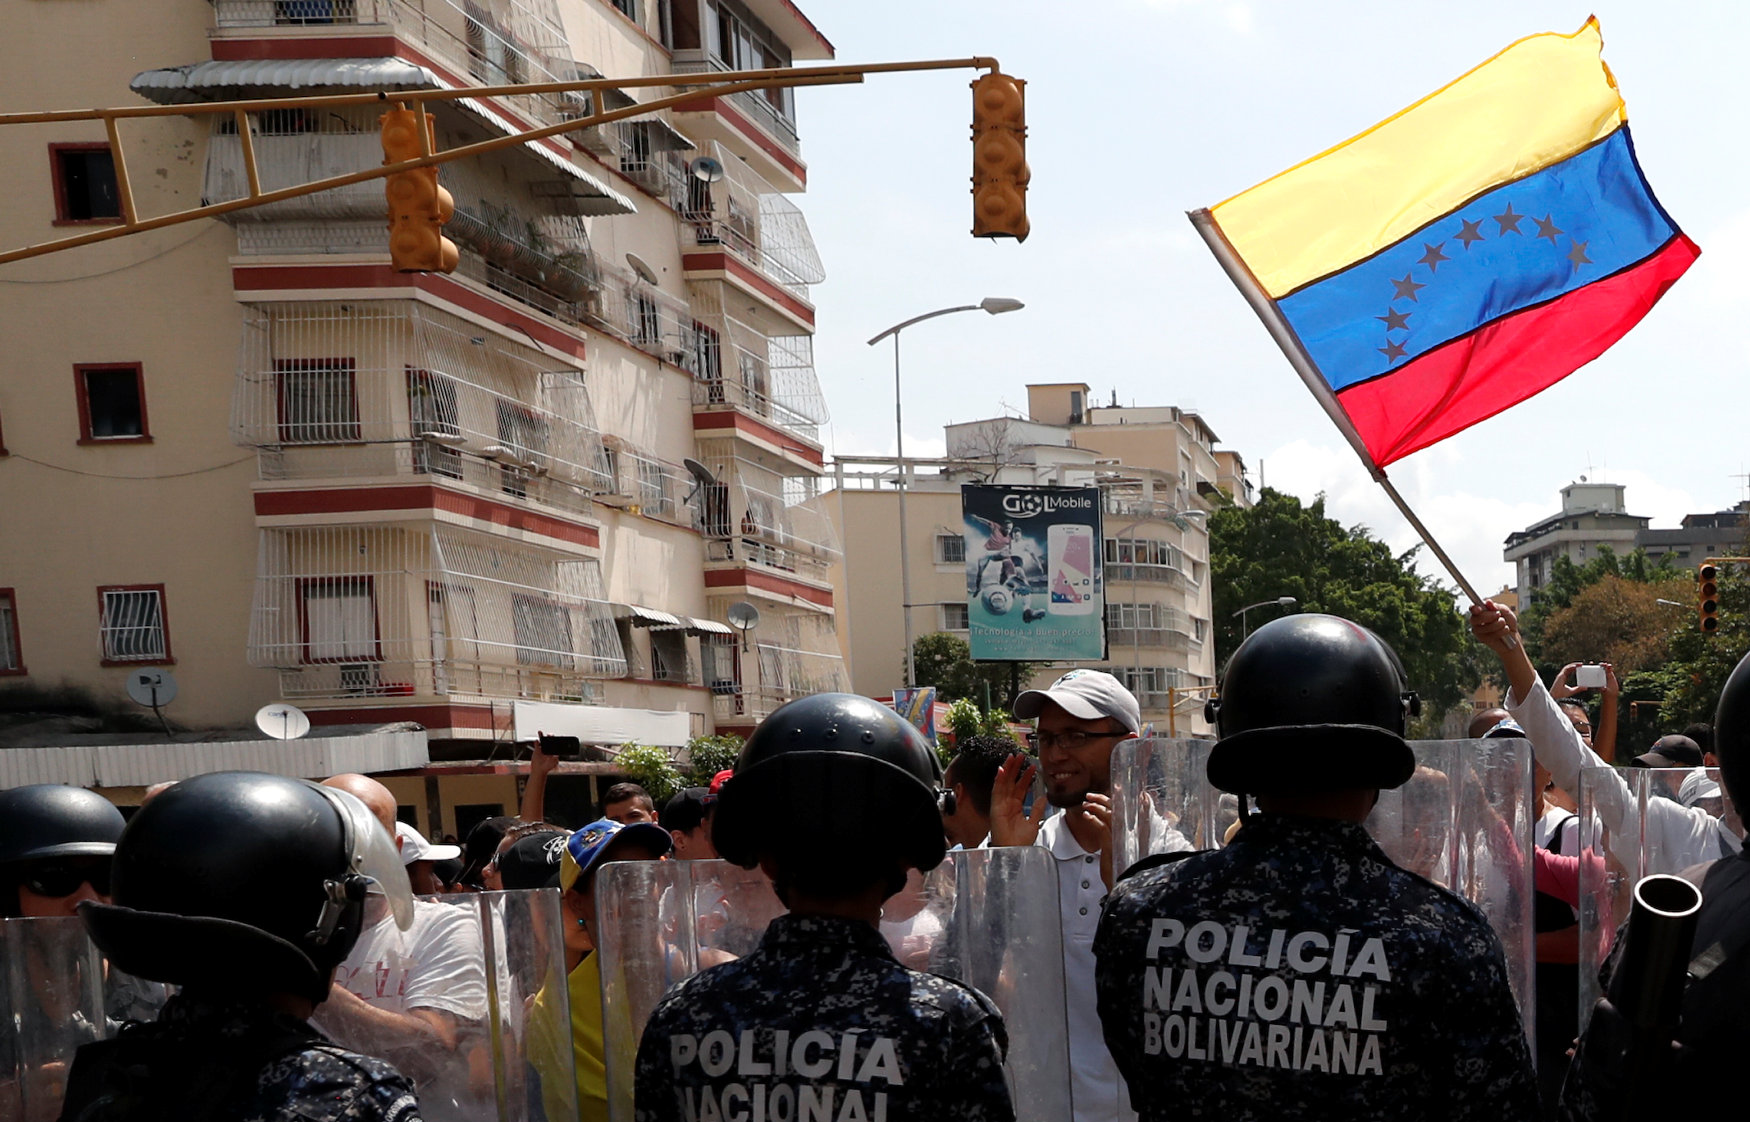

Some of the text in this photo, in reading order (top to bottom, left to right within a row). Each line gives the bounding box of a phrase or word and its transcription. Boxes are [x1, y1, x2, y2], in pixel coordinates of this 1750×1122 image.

[1050, 496, 1092, 510] Mobile
[1035, 626, 1060, 637] buen
[1145, 917, 1392, 983] POLICÍA
[1143, 965, 1388, 1032] NACIONAL
[670, 1026, 905, 1087] POLICÍA
[1143, 1011, 1384, 1077] BOLIVARIANA
